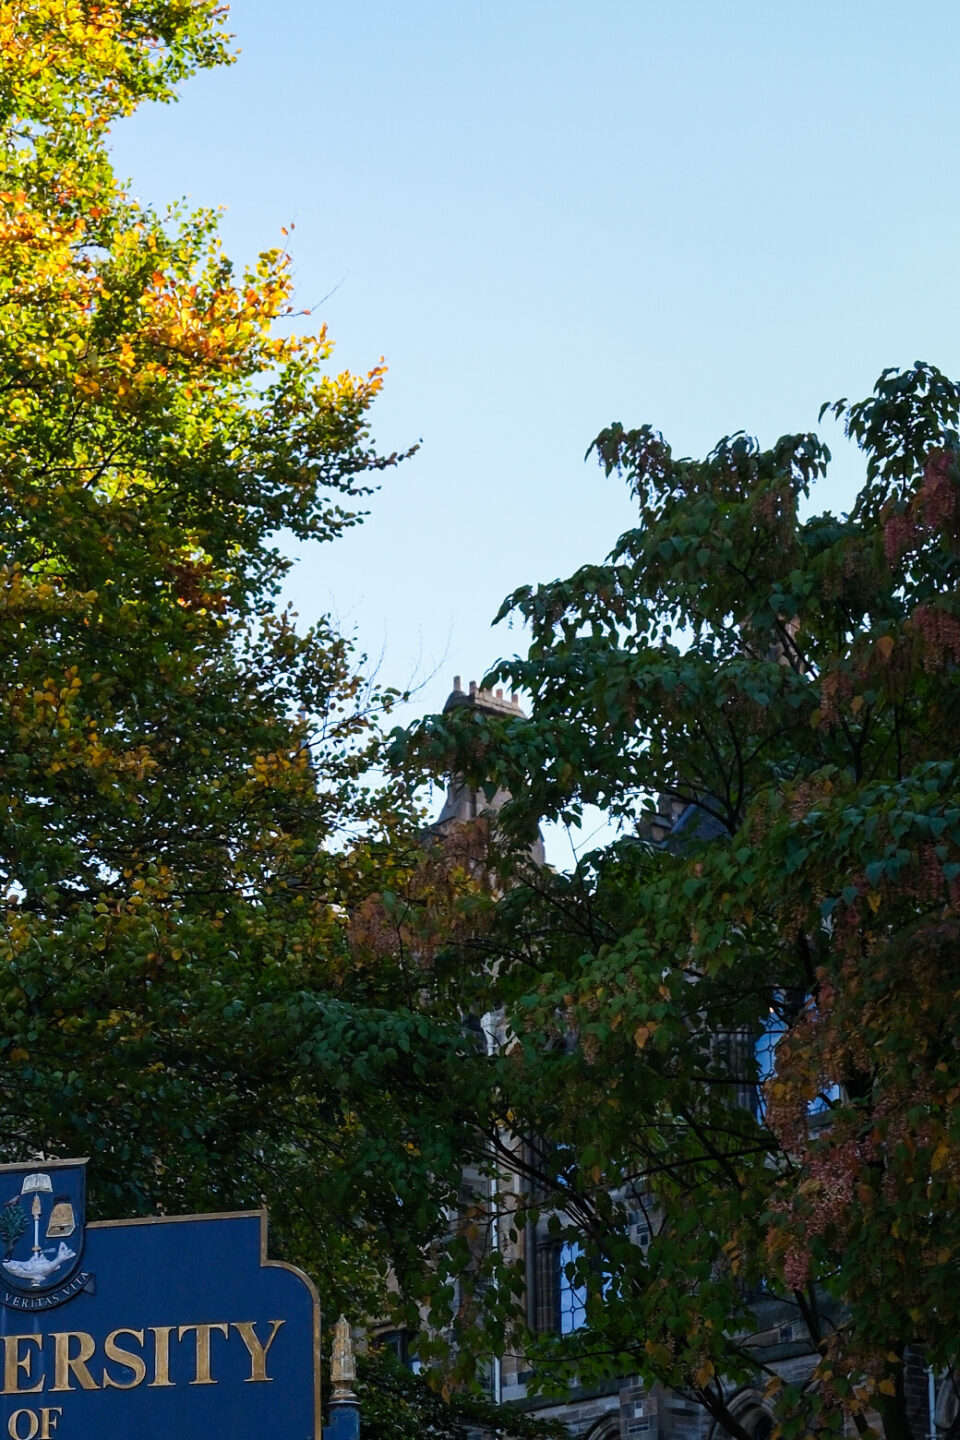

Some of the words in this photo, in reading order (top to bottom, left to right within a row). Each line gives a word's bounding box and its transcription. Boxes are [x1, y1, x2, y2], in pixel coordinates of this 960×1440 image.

[5, 1293, 60, 1308] VERITAS
[62, 1272, 89, 1295] VITA
[8, 1408, 62, 1440] OF
